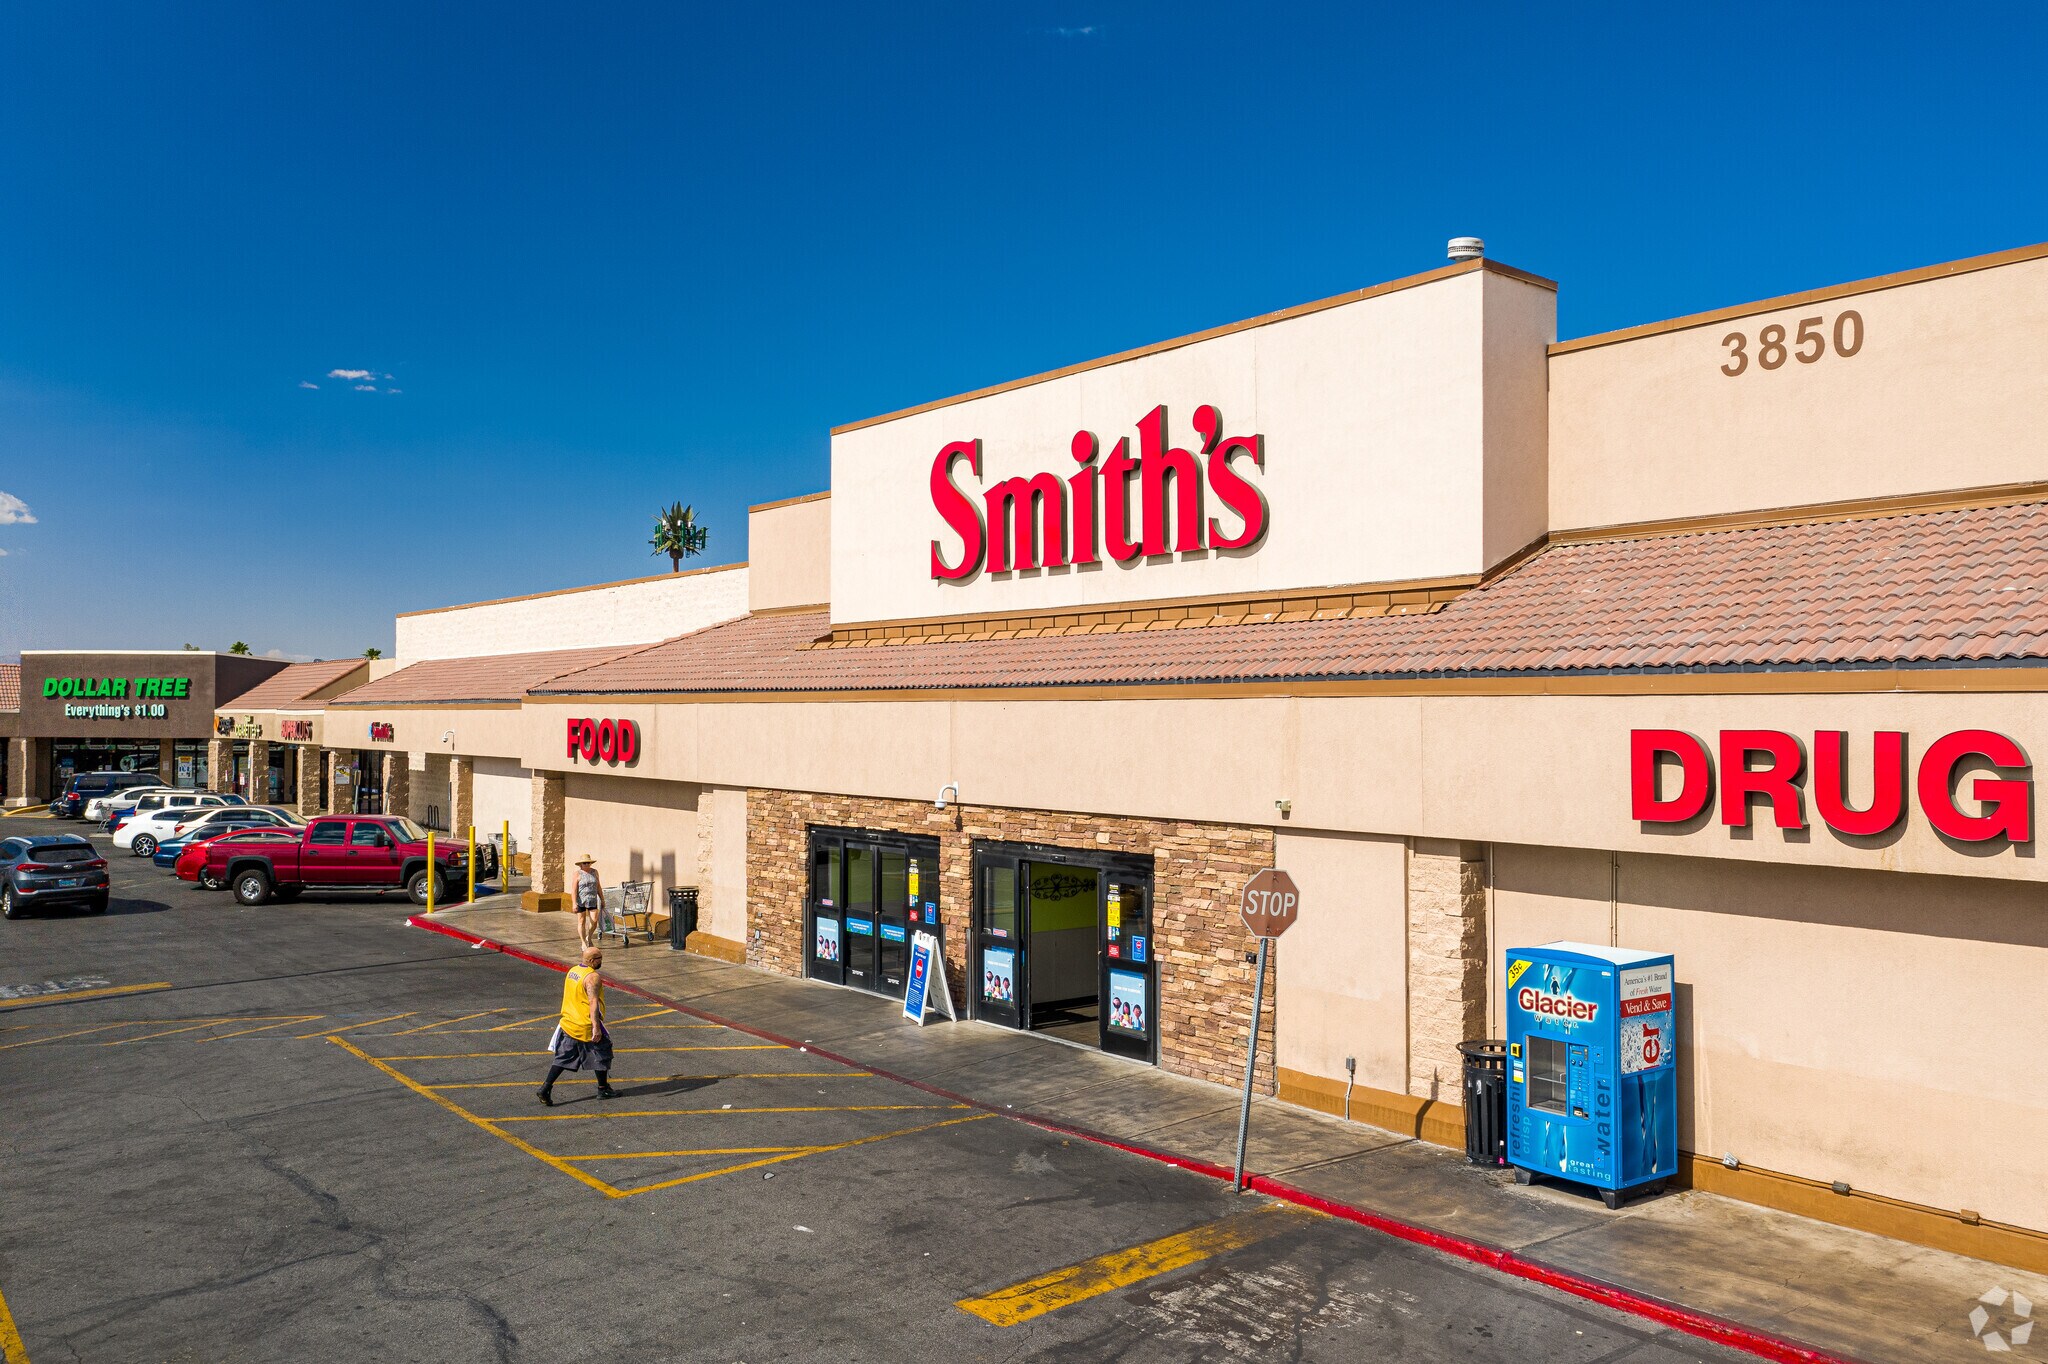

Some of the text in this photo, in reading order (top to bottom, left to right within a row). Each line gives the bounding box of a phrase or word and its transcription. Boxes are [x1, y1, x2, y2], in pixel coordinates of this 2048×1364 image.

[1720, 309, 1864, 377] 3850
[930, 404, 1267, 581] Smith's
[42, 677, 189, 697] DOLLAR TREE
[65, 703, 165, 718] Everything's $1.00
[567, 717, 637, 762] FOOD
[1631, 729, 2032, 843] DRUG
[1245, 889, 1296, 917] STOP
[1624, 975, 1647, 986] America's
[1654, 971, 1668, 981] Brand
[1629, 985, 1663, 997] of Fresh Water
[1519, 988, 1598, 1021] Glacier
[1625, 998, 1667, 1014] Vend & Save
[1510, 1083, 1521, 1157] refreshi
[1595, 1080, 1611, 1156] water
[1521, 1117, 1532, 1154] crisp
[1568, 1164, 1611, 1182] tasting
[1569, 1159, 1594, 1169] great
